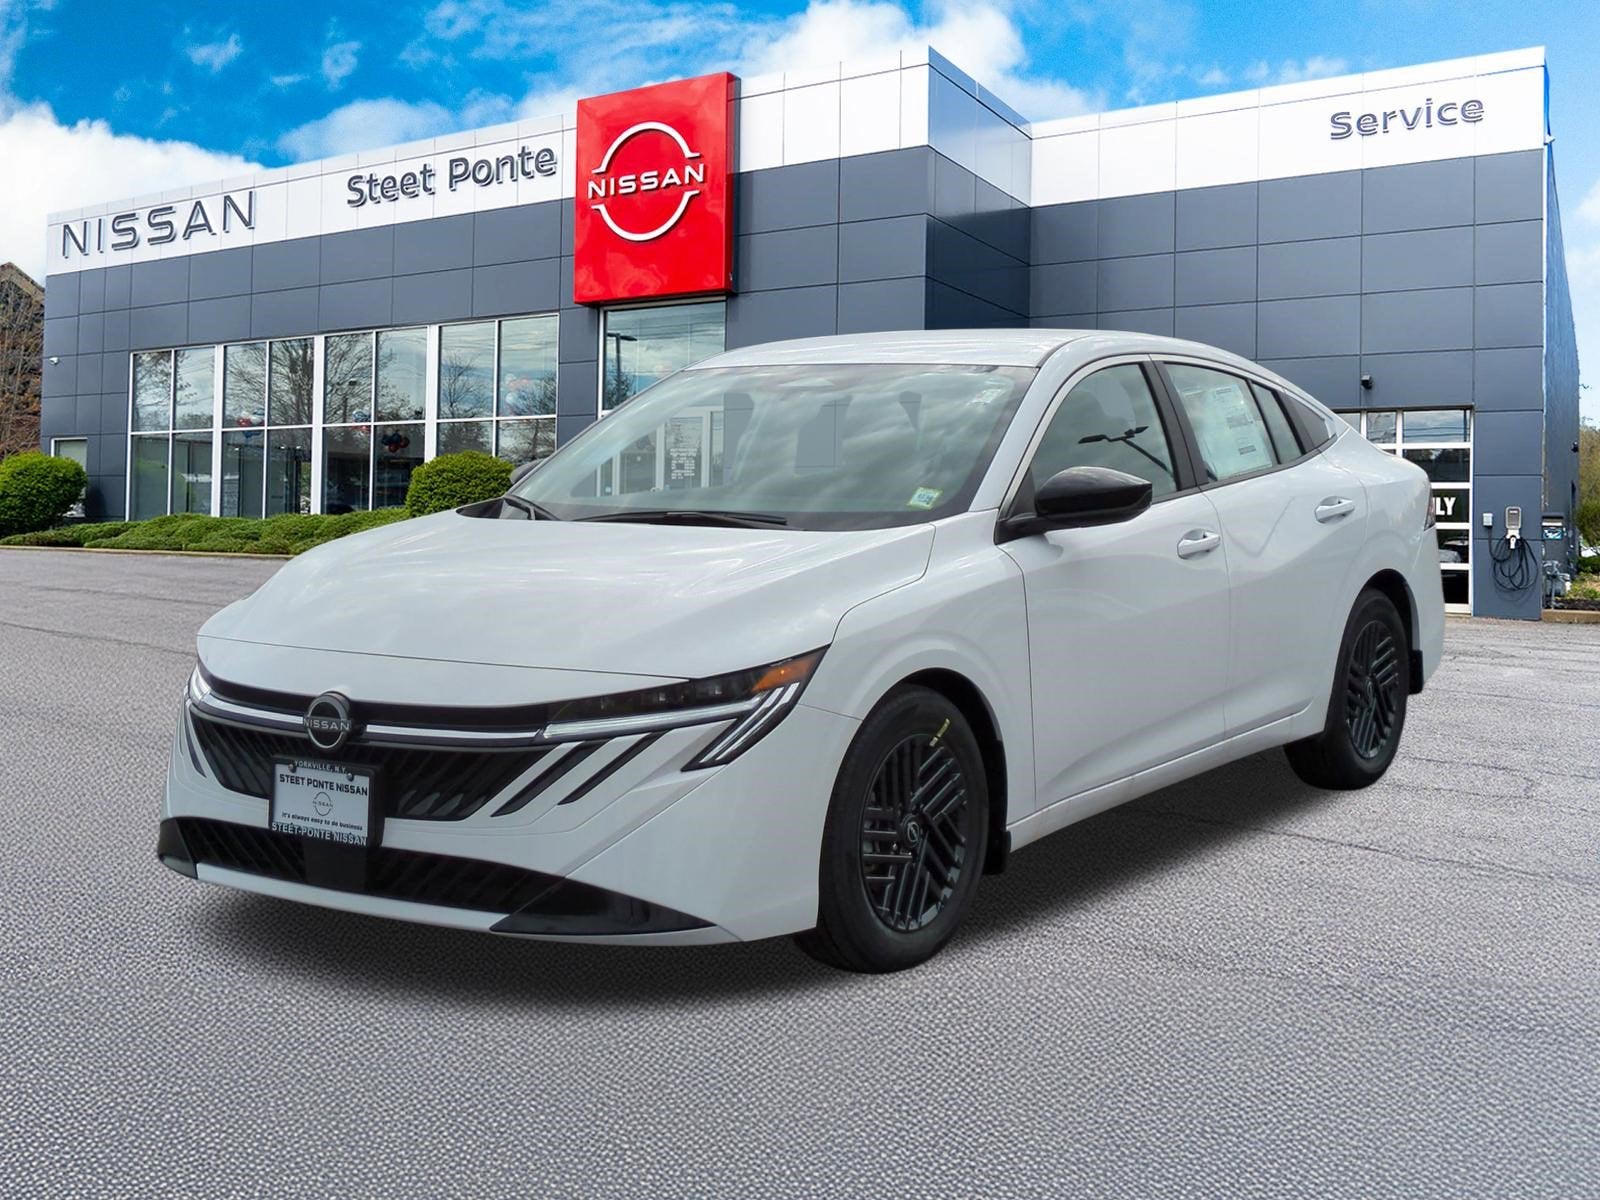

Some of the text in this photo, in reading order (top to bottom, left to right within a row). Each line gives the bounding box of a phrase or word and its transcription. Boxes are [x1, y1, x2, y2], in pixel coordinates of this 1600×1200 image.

[1330, 98, 1485, 140] Service
[347, 146, 557, 208] Steet Ponte
[587, 163, 705, 199] NISSAN
[62, 191, 256, 259] NISSAN
[1432, 496, 1456, 516] LY
[303, 718, 351, 731] NISSAN
[279, 773, 368, 796] STEET PONTE NISSAN
[291, 814, 310, 822] always
[311, 817, 323, 825] easy
[339, 822, 363, 831] business
[333, 833, 367, 846] NISSAN
